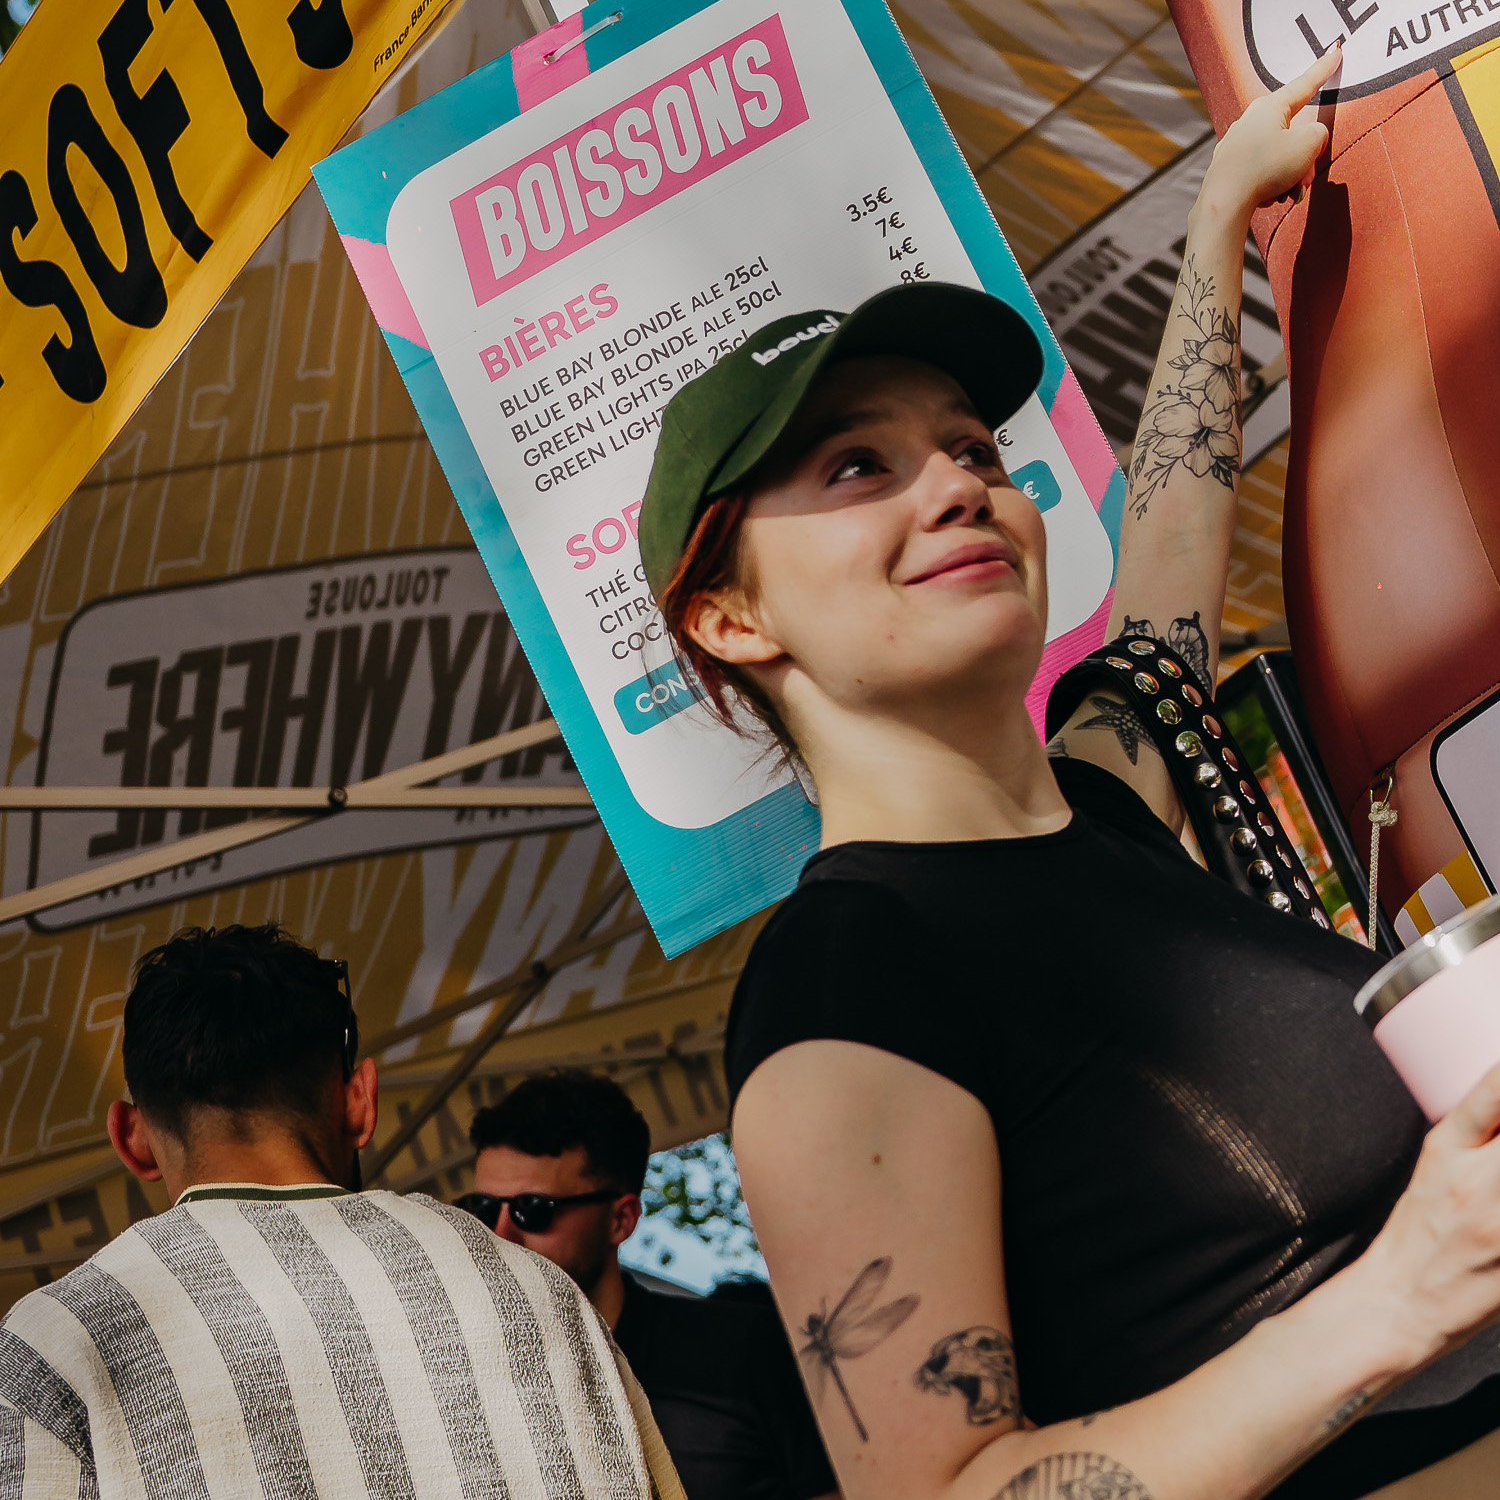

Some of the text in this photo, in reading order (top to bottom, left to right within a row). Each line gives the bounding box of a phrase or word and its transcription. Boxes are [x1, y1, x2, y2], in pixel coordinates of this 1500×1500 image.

[475, 39, 782, 280] BOISSONS
[478, 283, 619, 382] BIÈRES
[500, 186, 893, 419] BLUE BAY BLONDE ALE 25cl 3.5€
[511, 211, 905, 443] BLUE BAY BLONDE ALE 50cl 7€
[523, 417, 595, 467] GREEN
[597, 373, 673, 426] LIGHTS
[676, 358, 708, 383] IPA
[888, 236, 918, 261] 4€
[535, 442, 606, 493] GREEN
[900, 262, 930, 284] 8€
[566, 498, 644, 570] SOF
[585, 569, 630, 608] THÉ
[612, 622, 668, 659] COC
[635, 667, 700, 713] CONS
